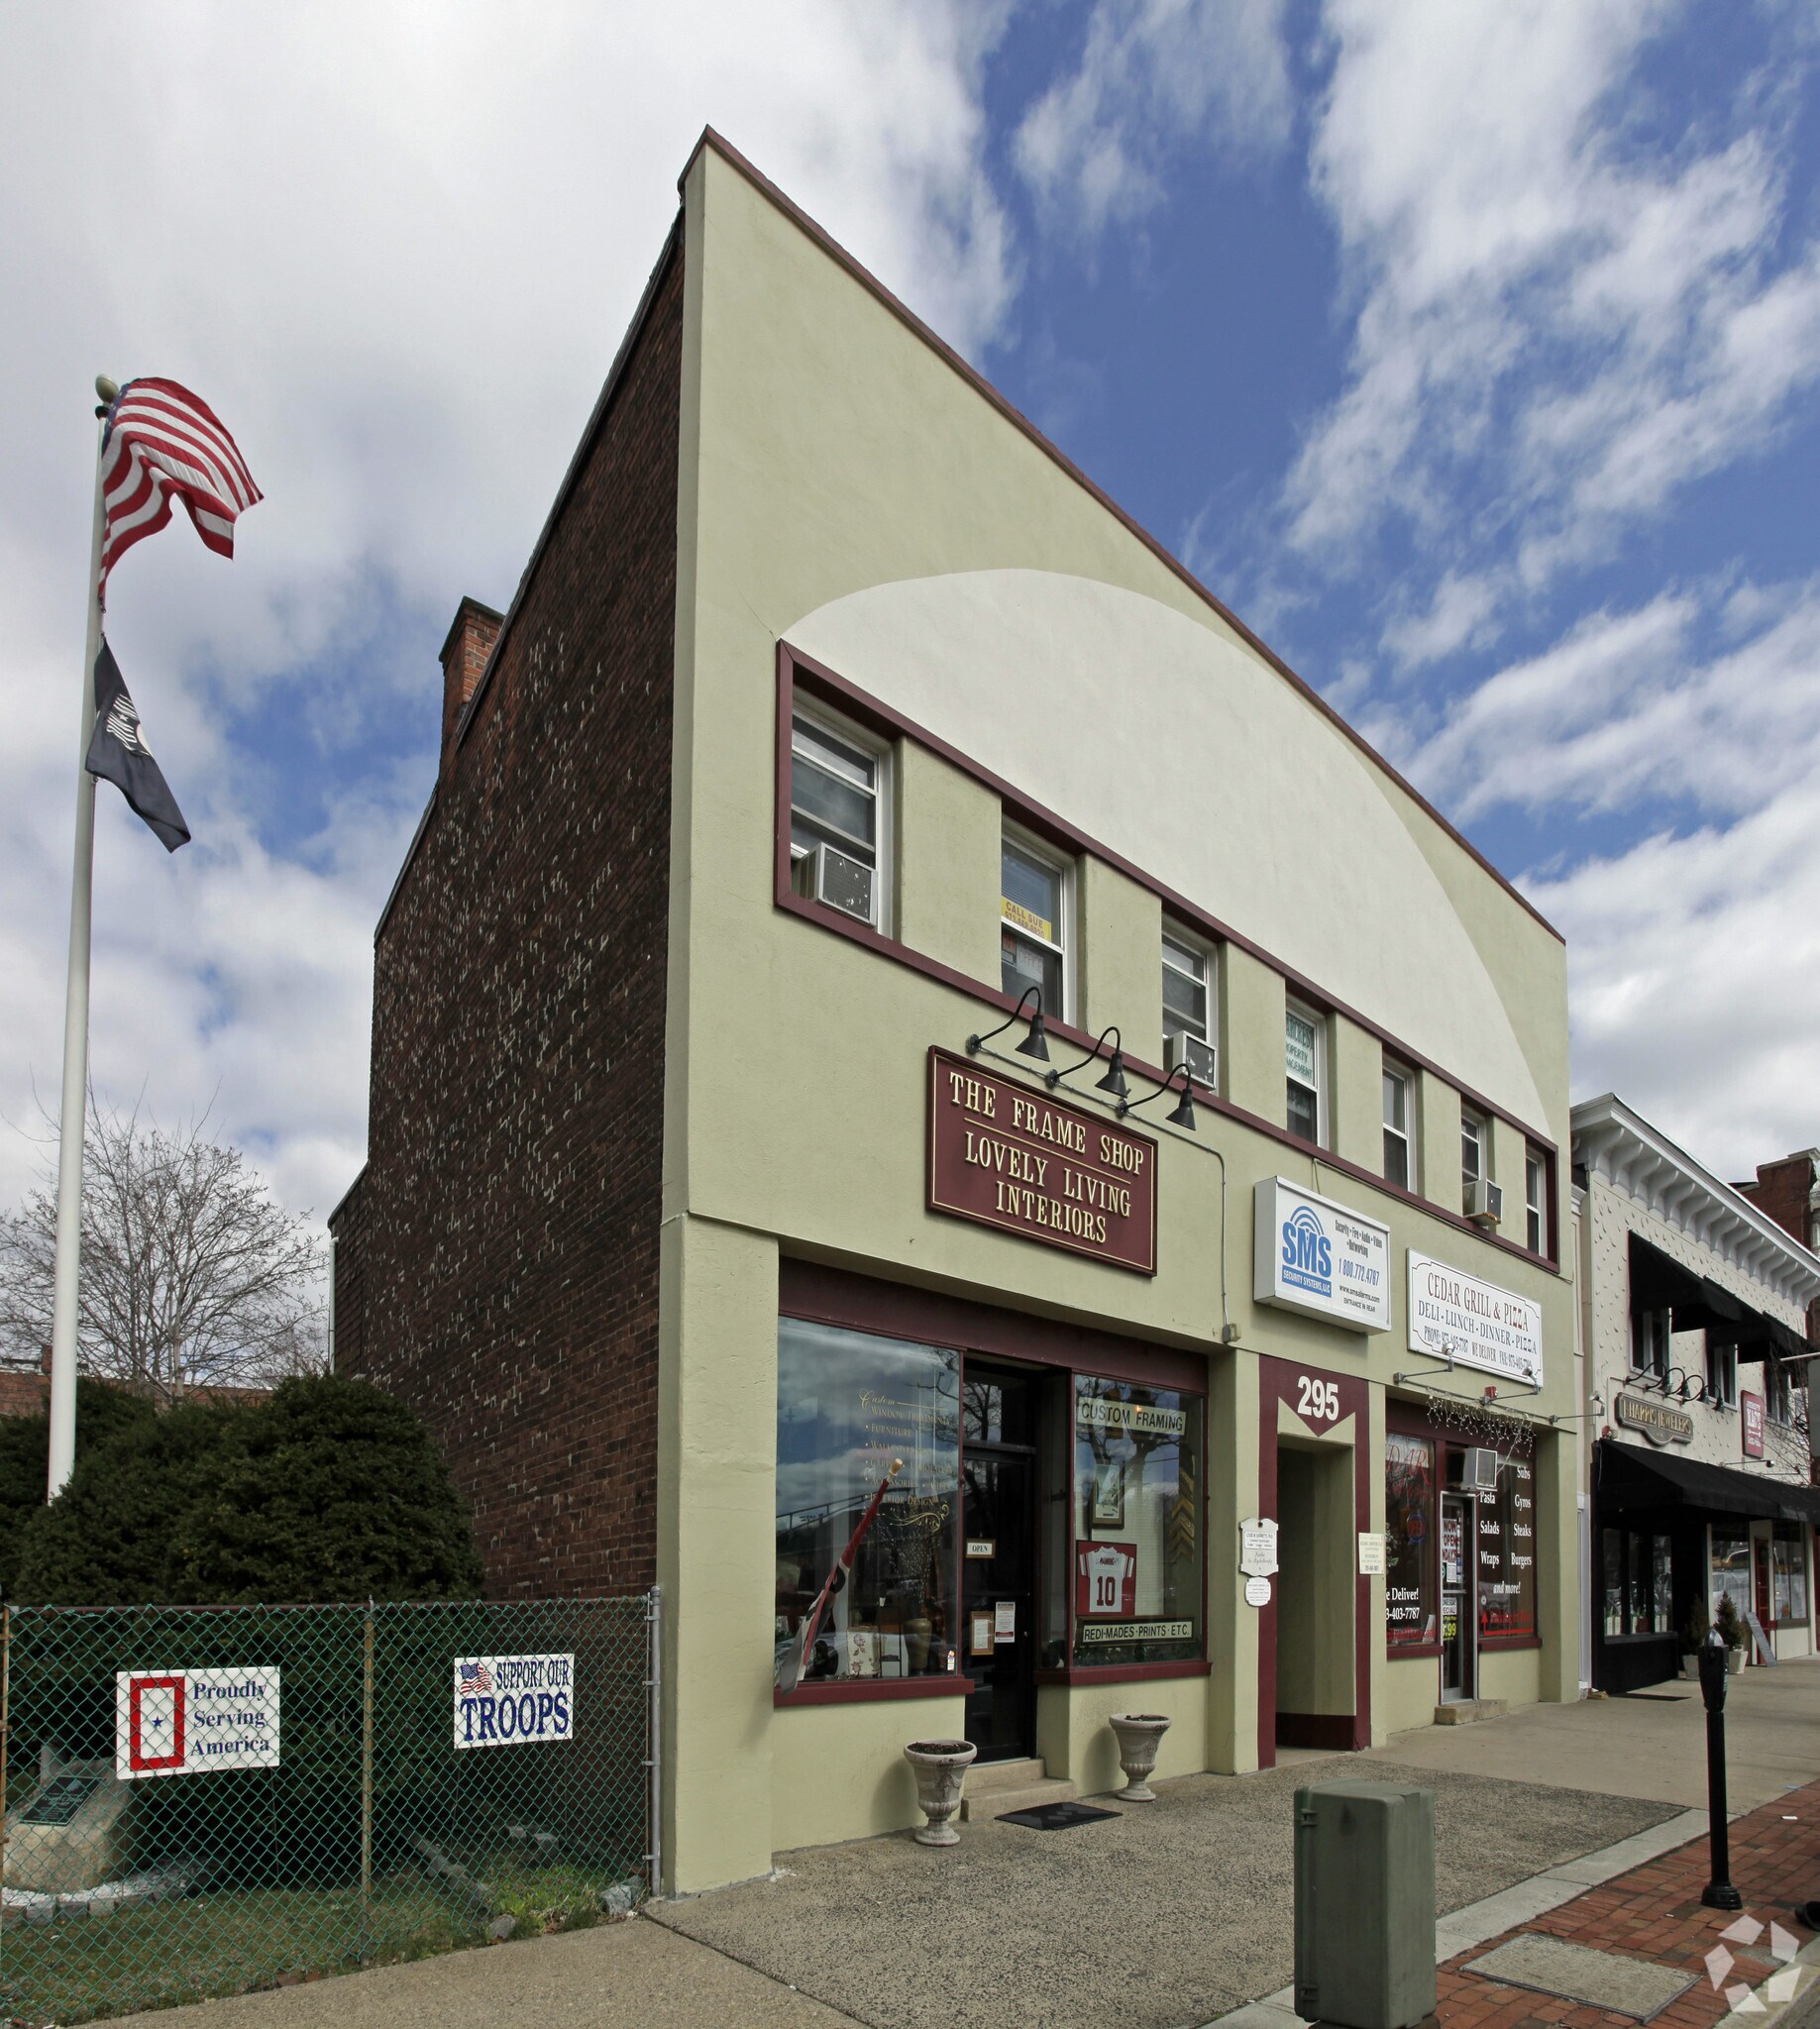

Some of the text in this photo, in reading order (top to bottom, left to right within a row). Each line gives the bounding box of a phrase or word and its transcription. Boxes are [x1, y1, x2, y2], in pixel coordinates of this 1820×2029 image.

[1007, 902, 1043, 928] CALL SUE
[949, 1071, 1144, 1175] THE FRAME SHOP
[965, 1131, 1131, 1218] LOVELY LIVING
[996, 1180, 1107, 1244] INTERIORS
[1335, 1220, 1349, 1237] Security
[1282, 1221, 1332, 1278] SMS
[1283, 1269, 1303, 1285] SECURITY
[1343, 1297, 1361, 1309] ENTRANCE
[1428, 1272, 1529, 1333] CEDAR GRILL & PIZZA
[1418, 1300, 1538, 1355] DELI LUNCH DINNER PIZZA
[859, 1388, 896, 1409] Custom
[1297, 1375, 1339, 1421] 295
[872, 1406, 904, 1419] WINDOW
[1082, 1402, 1183, 1431] CUSTOM FRAMING
[871, 1424, 912, 1438] FURNITURE
[1386, 1444, 1432, 1486] DAR
[1517, 1466, 1531, 1480] Subs
[1479, 1491, 1531, 1511] Pasta Gyros
[1480, 1521, 1532, 1537] Salads Steaks
[1480, 1551, 1532, 1569] Wraps Burgers
[1097, 1576, 1116, 1606] 10
[1391, 1587, 1419, 1601] Deliver!
[1493, 1581, 1521, 1594] and more!
[1386, 1607, 1420, 1621] 3-403-7787
[1084, 1624, 1190, 1641] REDI-MADES PRINTS ETC.
[495, 1659, 570, 1690] SUPPORT OUR
[193, 1681, 268, 1701] Proudly
[193, 1709, 266, 1728] Serving
[460, 1691, 569, 1741] TROOPS
[190, 1736, 269, 1757] America
